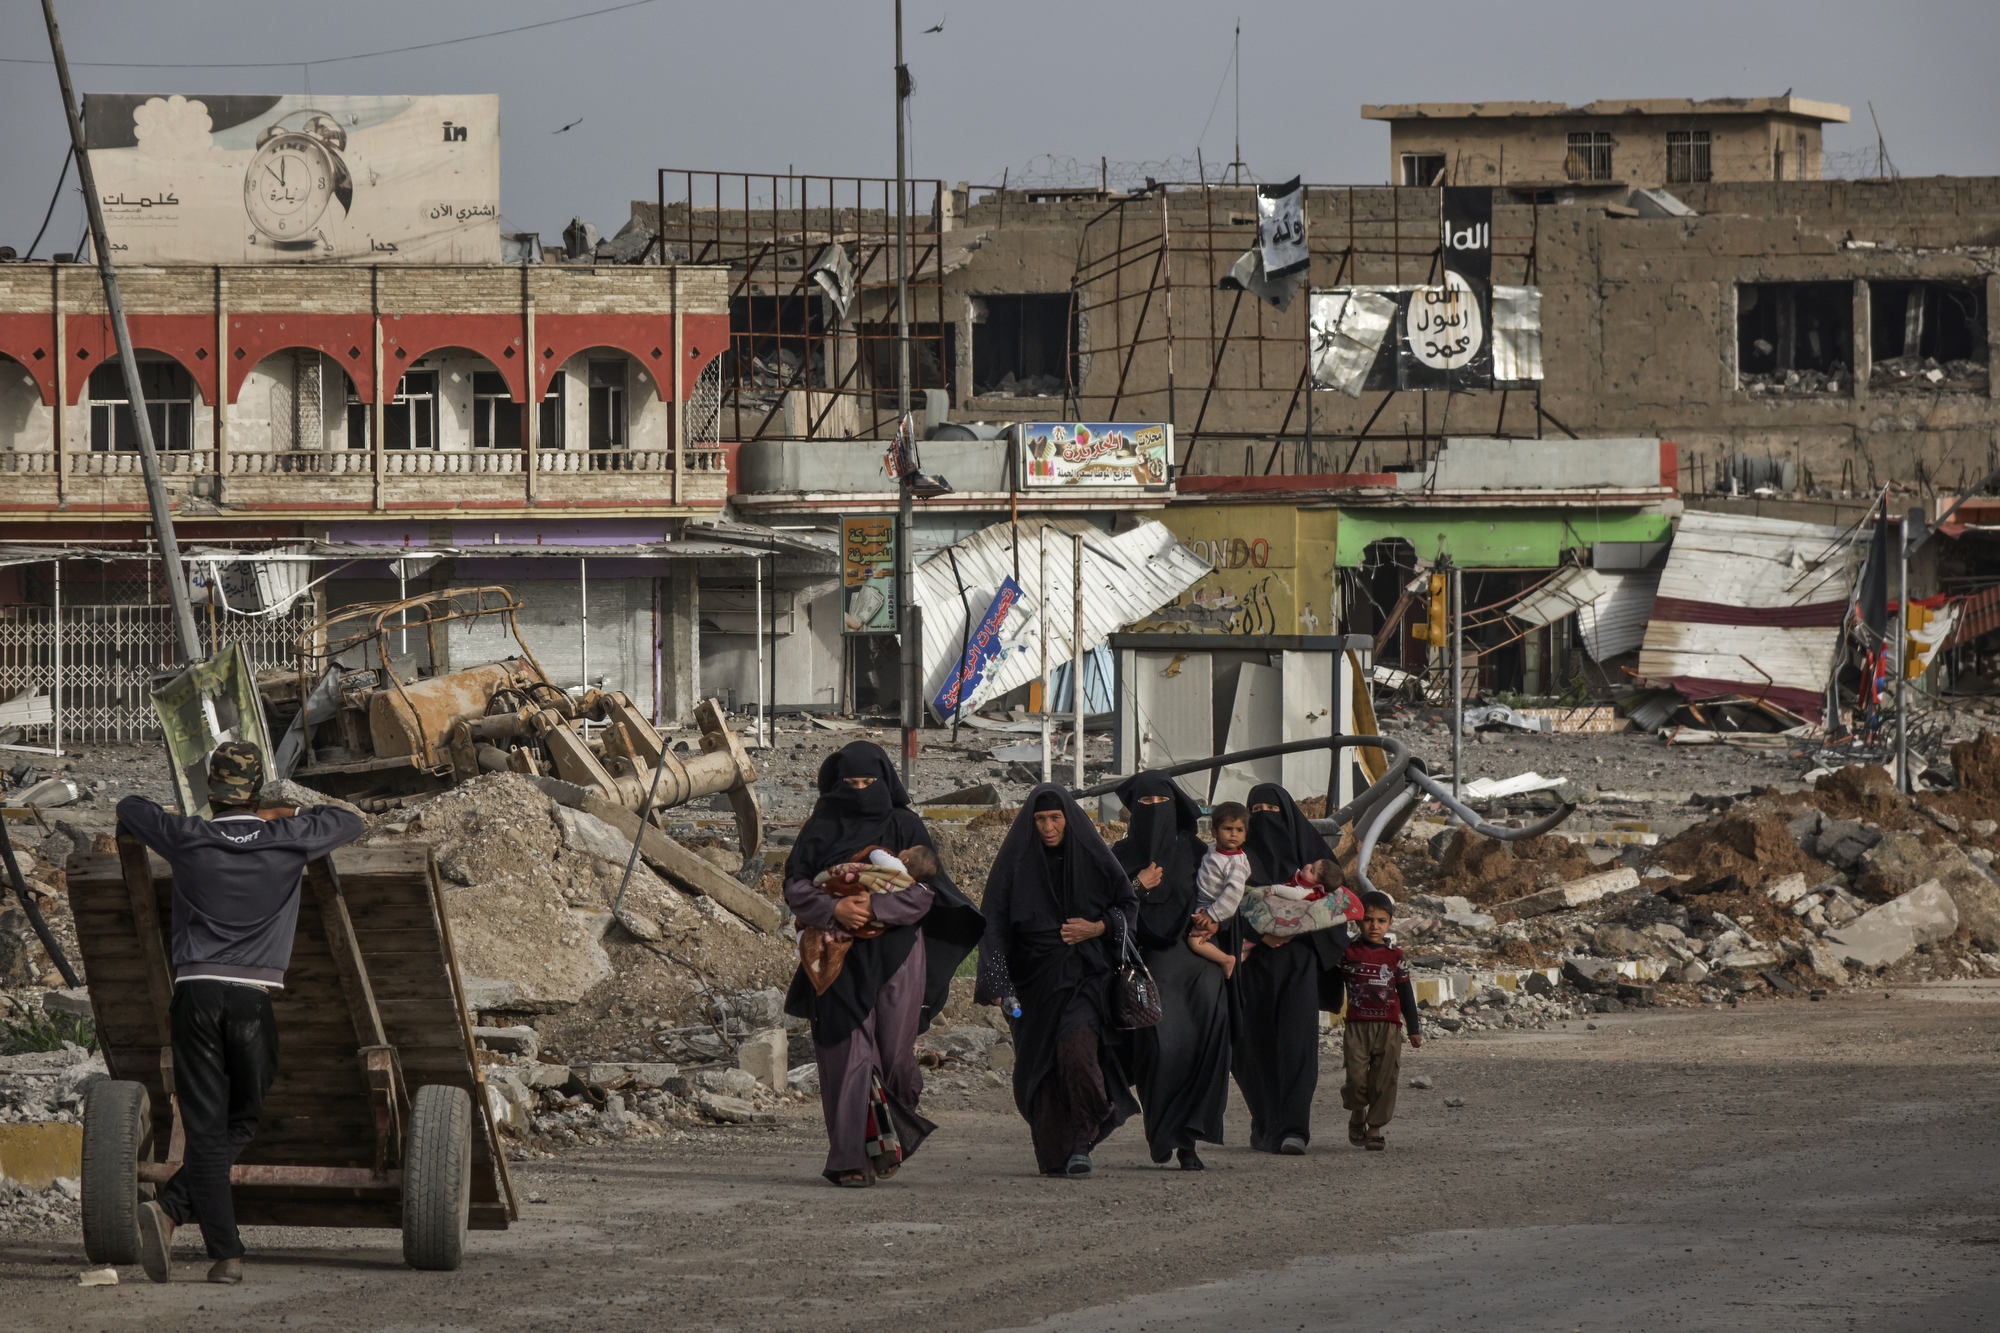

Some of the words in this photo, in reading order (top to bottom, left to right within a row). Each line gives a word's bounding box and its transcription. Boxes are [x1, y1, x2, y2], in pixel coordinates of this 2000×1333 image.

[102, 192, 179, 207] كلمات
[278, 217, 286, 231] 6
[1424, 336, 1470, 359] محمد
[848, 528, 893, 546] البركة
